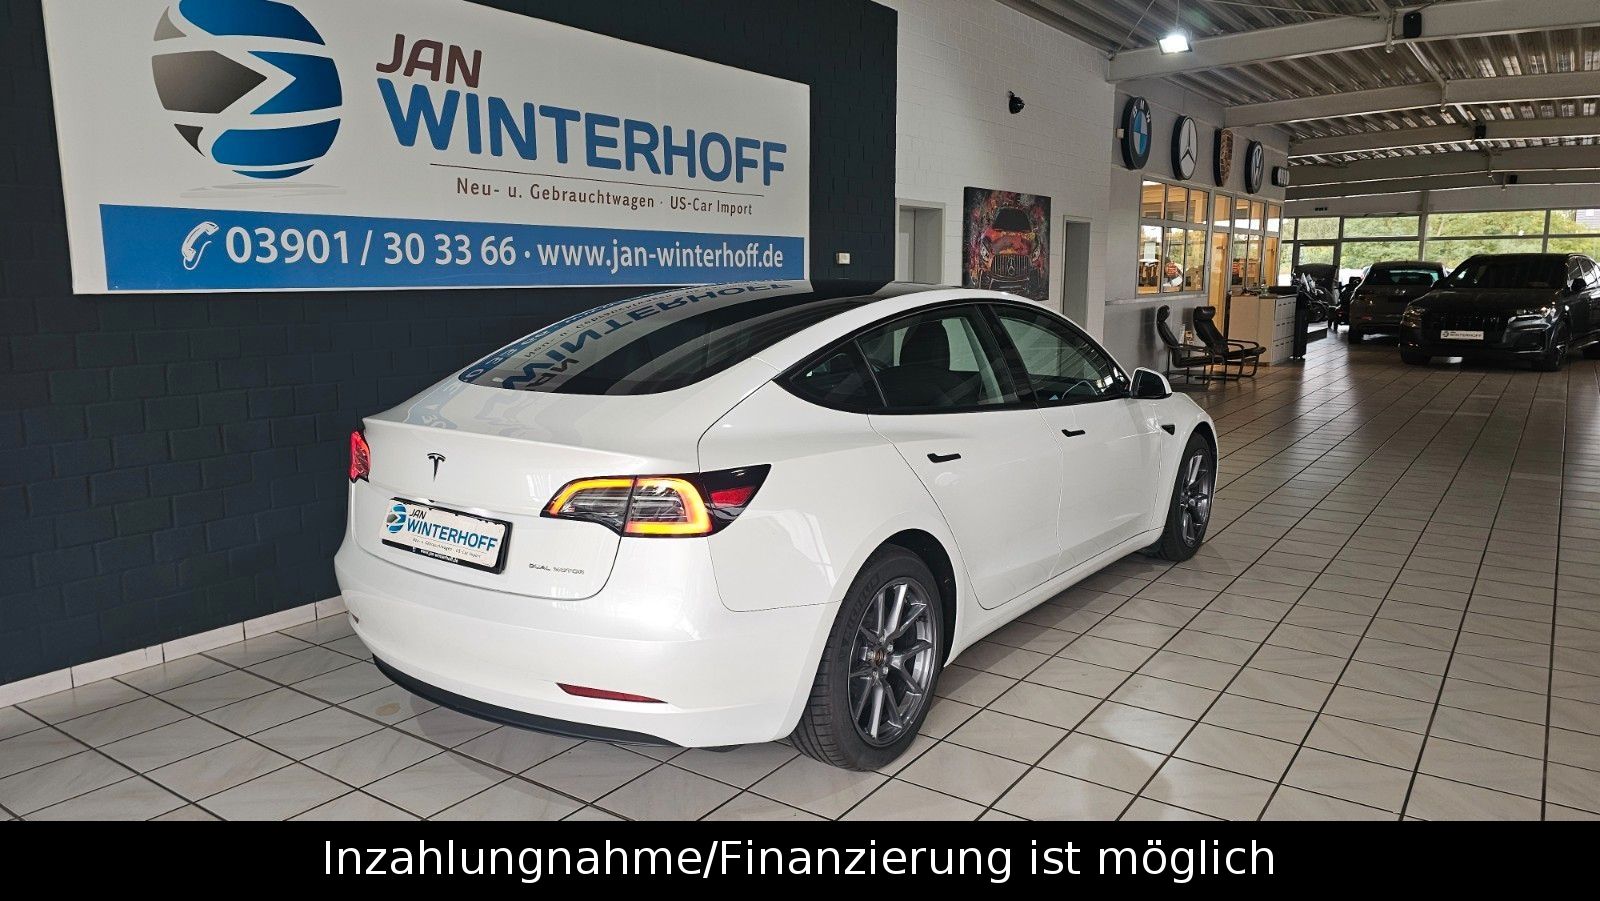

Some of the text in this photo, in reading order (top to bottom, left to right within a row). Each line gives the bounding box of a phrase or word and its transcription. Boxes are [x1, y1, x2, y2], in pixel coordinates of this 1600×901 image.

[376, 33, 482, 88] JAN
[377, 78, 787, 187] WINTERHOFF
[457, 177, 753, 216] Neu- u. Gebrauchtwagen US-Car Import
[225, 226, 349, 264] 03901
[384, 231, 425, 266] 30
[434, 233, 472, 265] 33
[480, 235, 517, 266] 66
[537, 238, 783, 275] www.jan-winterhoff.de
[407, 518, 498, 551] WINTERHOFF
[409, 509, 427, 520] JAN
